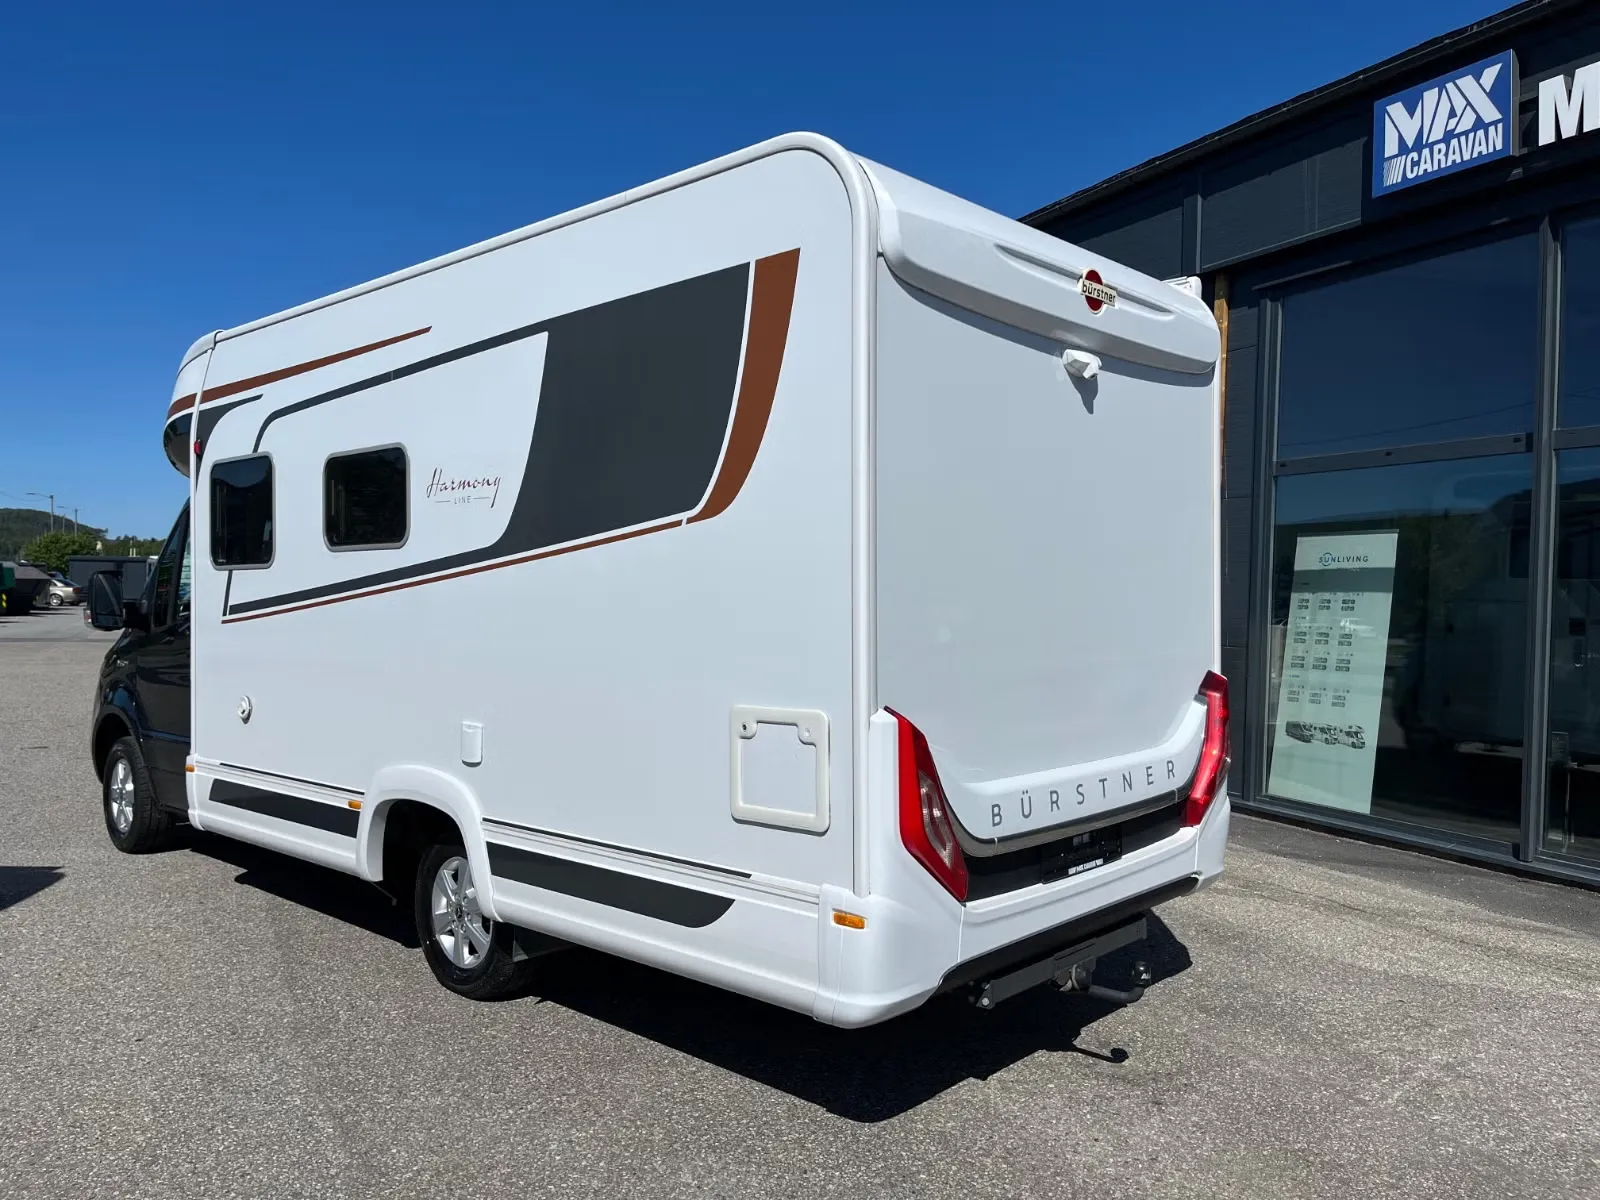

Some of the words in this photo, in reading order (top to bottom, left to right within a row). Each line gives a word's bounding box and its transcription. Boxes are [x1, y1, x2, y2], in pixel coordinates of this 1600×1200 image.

[1384, 62, 1504, 159] MAX
[1405, 122, 1503, 180] CARAVAN
[1082, 280, 1116, 303] bürstner
[426, 467, 501, 508] Harmony
[453, 495, 472, 505] LINE
[1318, 554, 1369, 565] SUNLIVING
[991, 760, 1176, 827] BÜRSTNER
